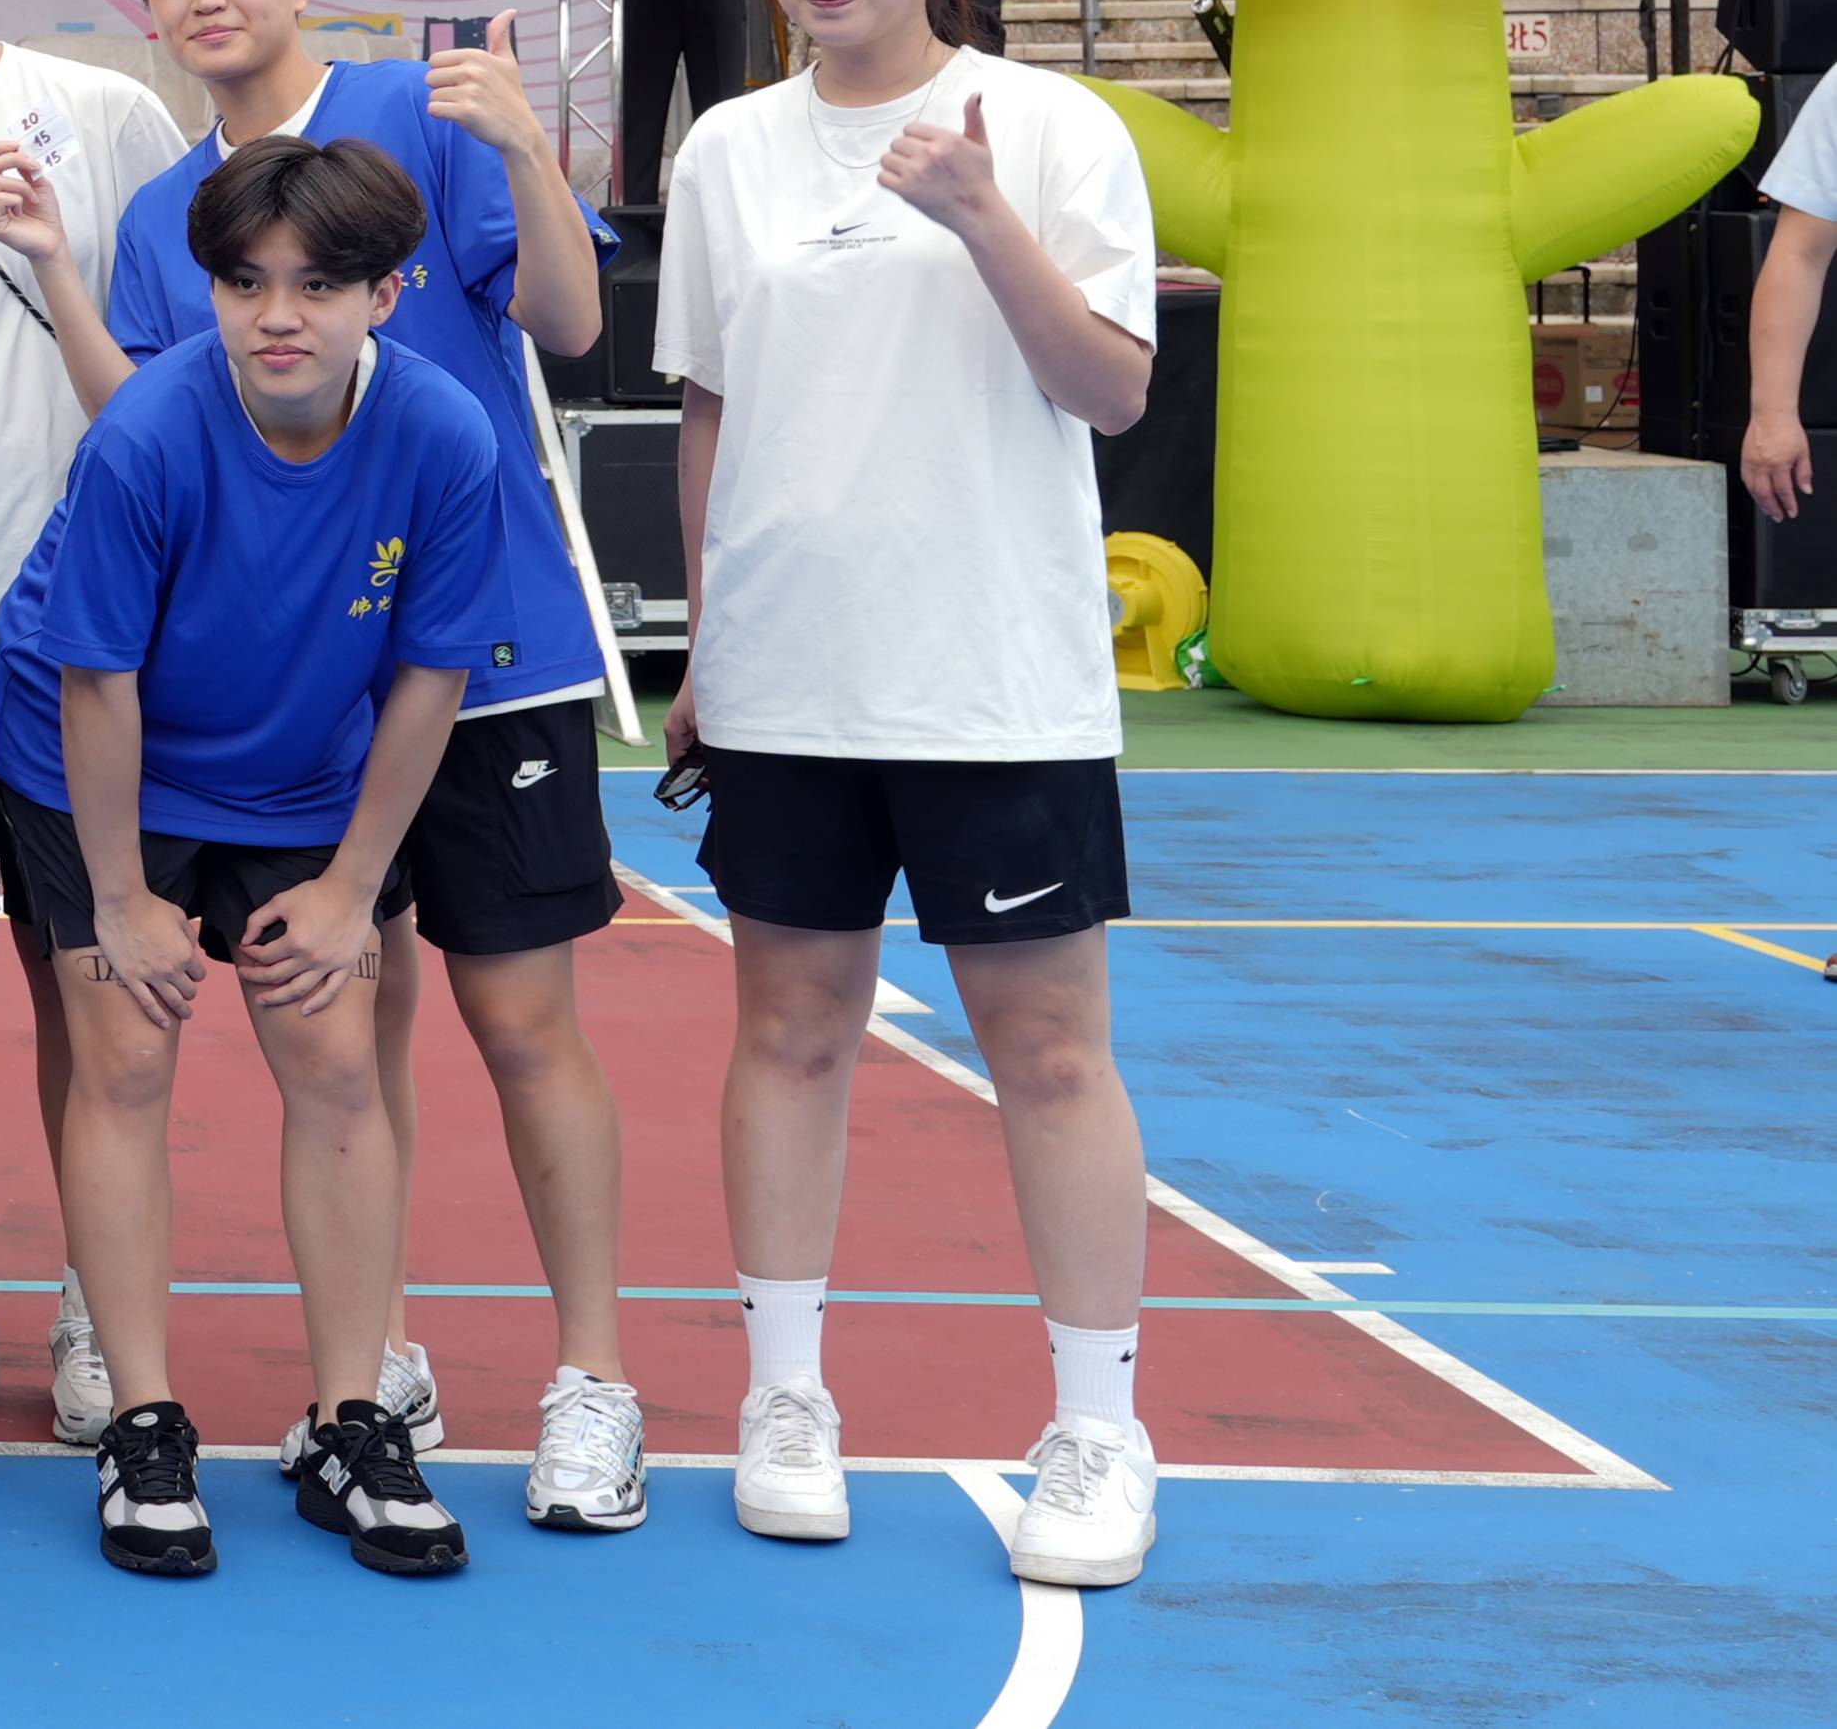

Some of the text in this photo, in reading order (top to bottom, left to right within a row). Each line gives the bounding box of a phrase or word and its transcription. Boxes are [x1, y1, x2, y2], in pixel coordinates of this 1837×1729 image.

[22, 112, 39, 131] 20
[34, 130, 51, 147] 15
[45, 151, 62, 167] 15
[519, 760, 549, 776] NIKE
